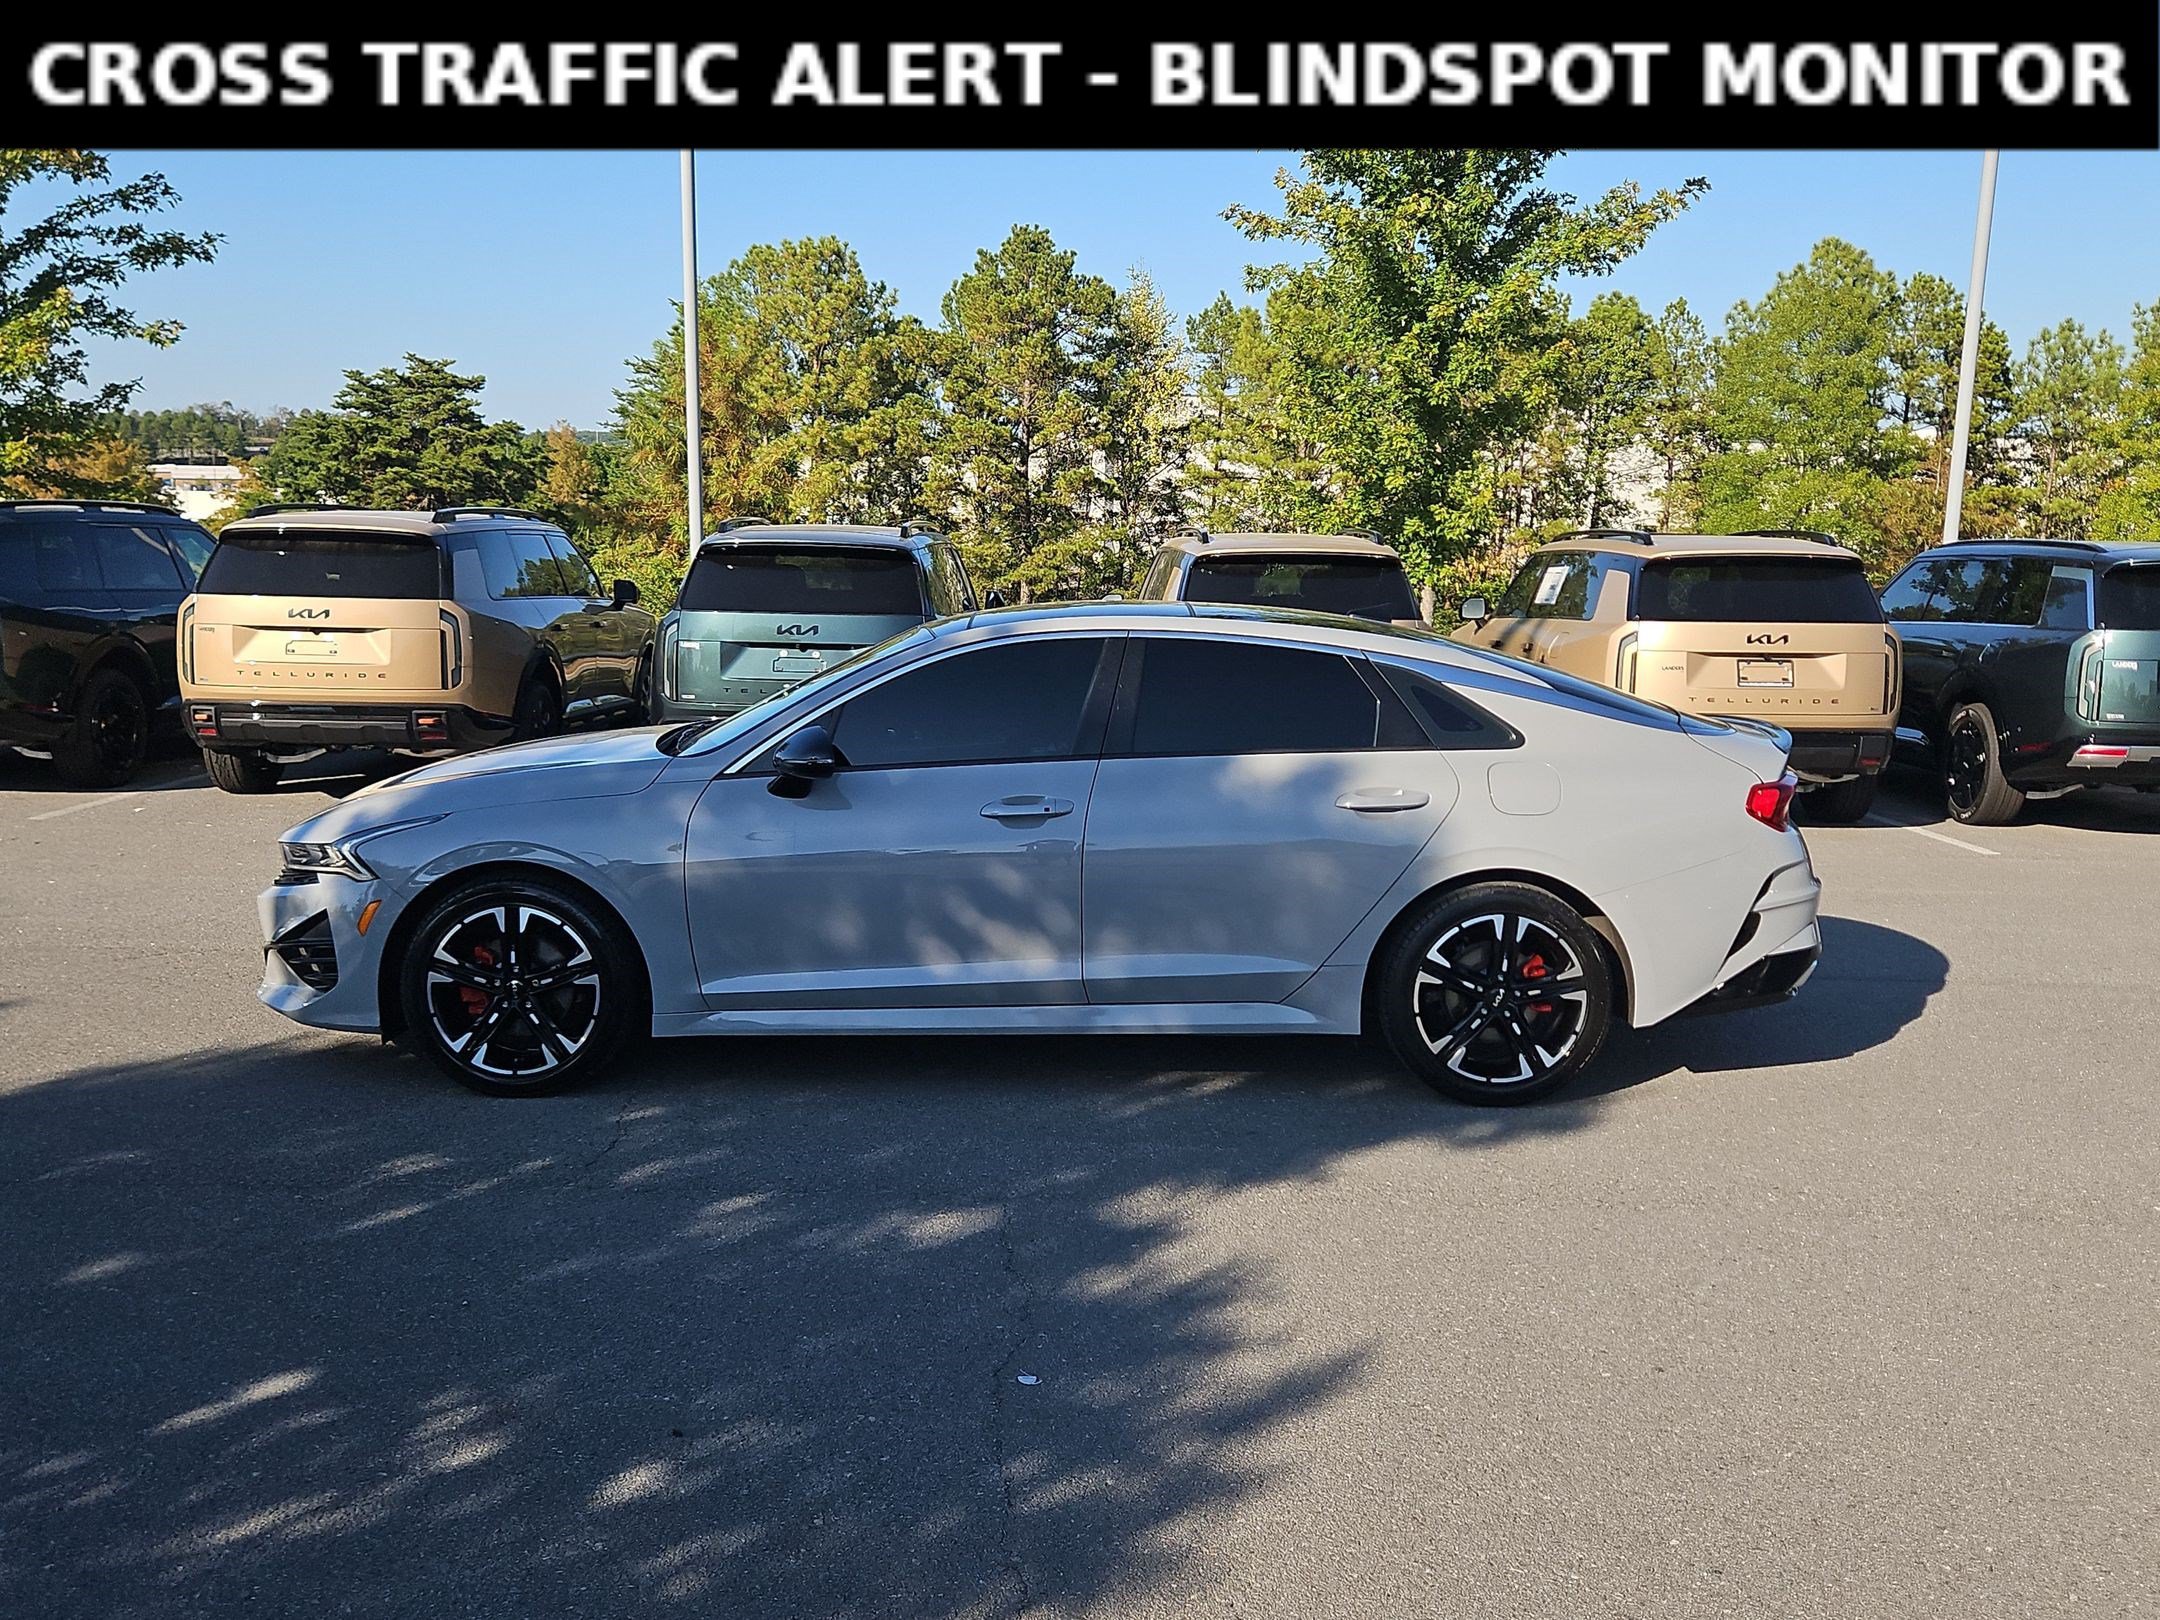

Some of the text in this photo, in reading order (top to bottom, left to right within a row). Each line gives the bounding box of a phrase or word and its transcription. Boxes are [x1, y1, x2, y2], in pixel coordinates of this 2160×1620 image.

[288, 608, 330, 619] KIA
[776, 624, 819, 636] KIA
[1746, 634, 1789, 645] KIA
[237, 670, 387, 679] TELLURIDE
[1688, 696, 1840, 705] TELLURIDE
